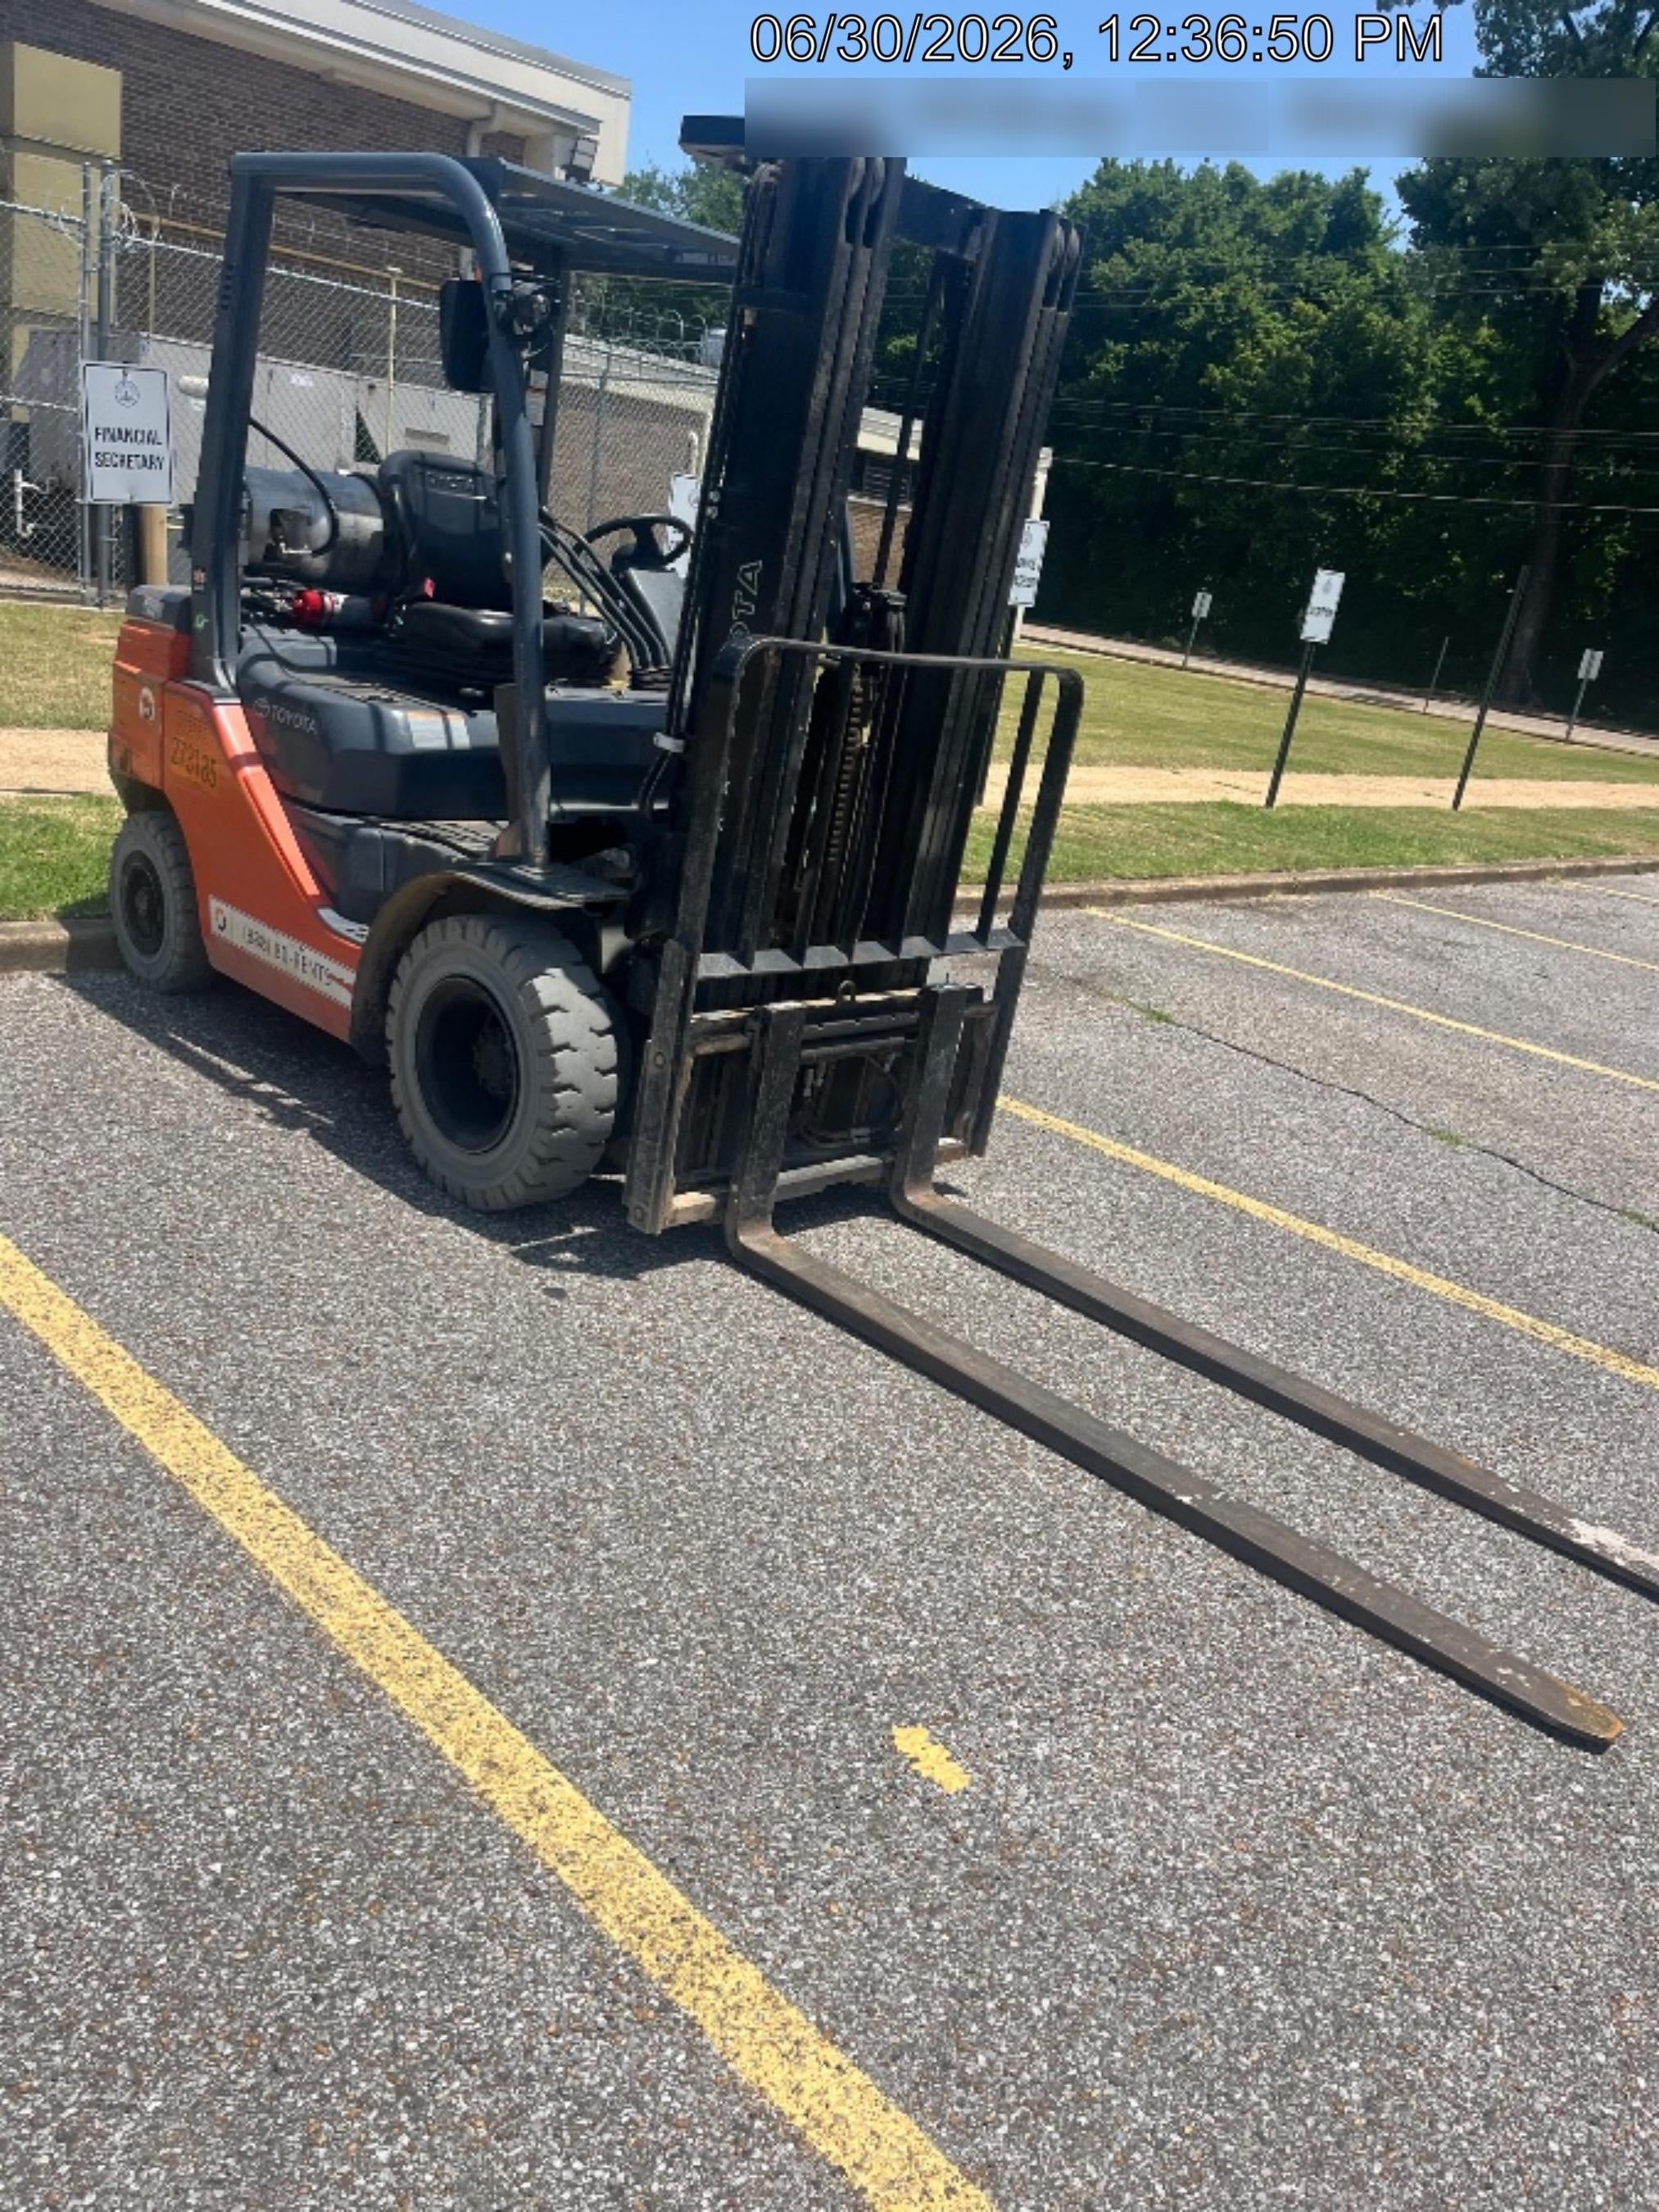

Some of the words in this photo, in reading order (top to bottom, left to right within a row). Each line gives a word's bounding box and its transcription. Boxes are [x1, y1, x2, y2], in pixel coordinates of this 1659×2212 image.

[94, 427, 163, 446] FINANCIAL
[94, 451, 165, 470] SECRETARY
[271, 705, 319, 735] TOYOTA
